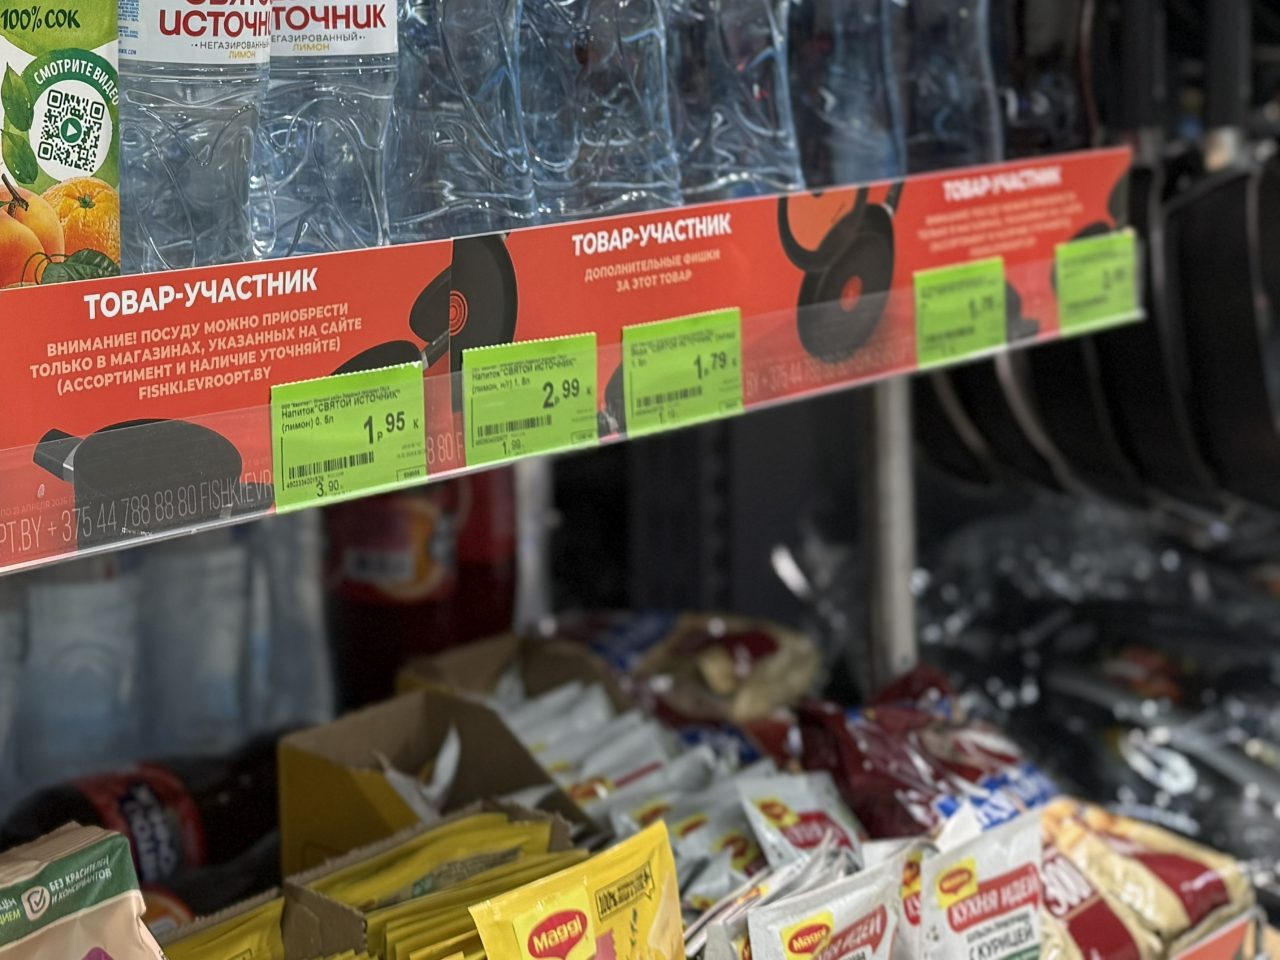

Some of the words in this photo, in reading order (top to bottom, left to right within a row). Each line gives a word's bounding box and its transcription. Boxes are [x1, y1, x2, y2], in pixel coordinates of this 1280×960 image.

[0, 5, 43, 32] 100%
[44, 8, 81, 29] СОК
[228, 50, 256, 59] ЛИМОН
[292, 43, 330, 52] ЛИМОН
[33, 59, 94, 85] СМОТРИТЕ
[92, 67, 119, 105] ВИДЕО
[572, 213, 732, 256] ТОВАР-УЧАСТНИК
[584, 255, 683, 282] ДОПОЛНИТЕЛЬНЫЕ
[616, 280, 630, 292] ЗА
[632, 276, 658, 289] ЭТОТ
[659, 269, 692, 284] ТОВАР
[84, 267, 318, 320] ТОВАР-УЧАСТНИК
[47, 332, 138, 357] ВНИМАНИЕ!
[141, 323, 200, 343] ПОСУДУ
[204, 316, 260, 334] МОЖНО
[262, 303, 349, 326] ПРИОБРЕСТИ
[30, 357, 93, 379] ТОЛЬКО
[97, 356, 106, 369] В
[110, 341, 206, 367] МАГАЗИНАХ,
[208, 327, 296, 352] УКАЗАННЫХ
[298, 325, 317, 339] НА
[320, 317, 362, 336] САЙТЕ
[57, 366, 173, 396] (АССОРТИМЕНТ
[176, 363, 186, 375] И
[190, 351, 257, 372] НАЛИЧИЕ
[259, 336, 341, 363] УТОЧНЯЙТЕ)
[693, 354, 702, 380] 1
[709, 350, 726, 370] 79
[138, 366, 272, 400] FISHKI.EVROOPT.BY
[543, 381, 554, 409] 2
[562, 378, 580, 399] 99
[281, 407, 315, 419] Напиток
[281, 420, 314, 434] (лимон)
[363, 415, 374, 445] 1
[385, 411, 405, 433] 95
[437, 433, 453, 461] 80
[316, 481, 324, 498] 3
[328, 480, 339, 491] 90
[62, 505, 92, 542] 375
[97, 501, 117, 533] 44
[122, 494, 150, 528] 788
[154, 490, 174, 522] 88
[178, 485, 196, 516] 80
[533, 915, 583, 953] Maggi
